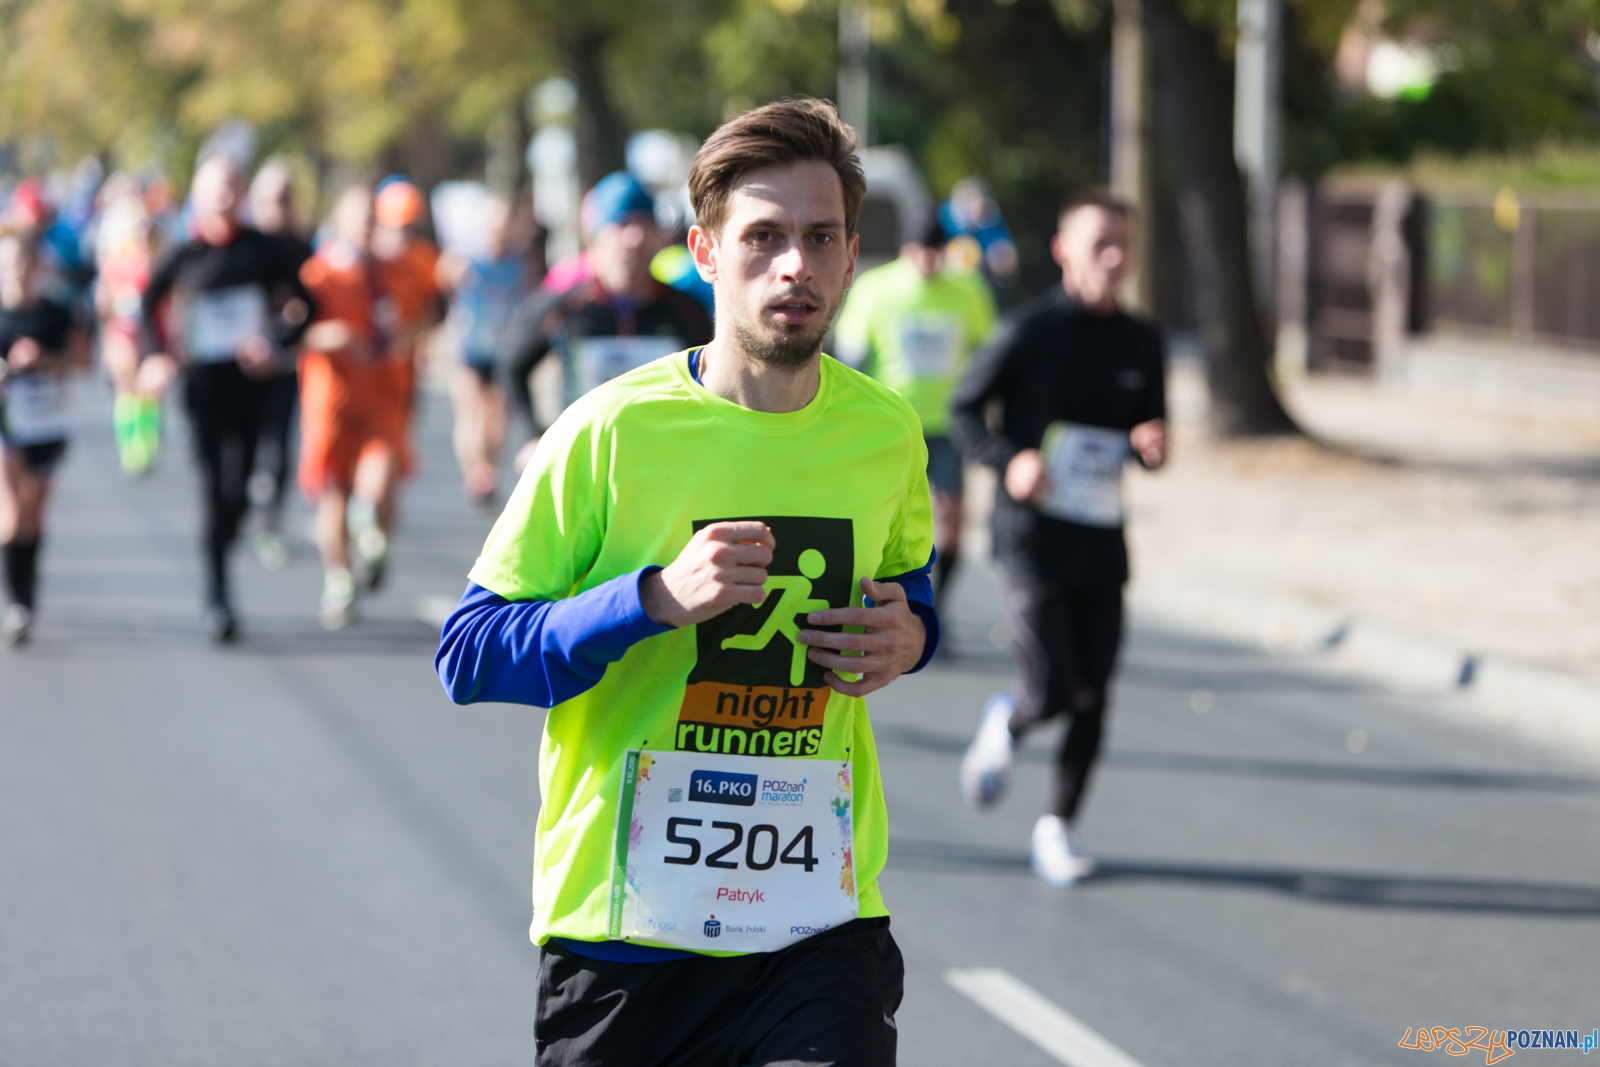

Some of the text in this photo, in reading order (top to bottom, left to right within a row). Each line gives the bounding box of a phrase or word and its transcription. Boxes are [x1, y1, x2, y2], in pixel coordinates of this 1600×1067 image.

[716, 687, 815, 727] night
[677, 723, 822, 756] runners
[695, 778, 752, 797] 16. PKO
[761, 791, 804, 802] maraton
[663, 816, 819, 873] 5204
[716, 887, 765, 905] Patryk
[725, 925, 744, 933] Bank
[746, 925, 766, 933] Polski
